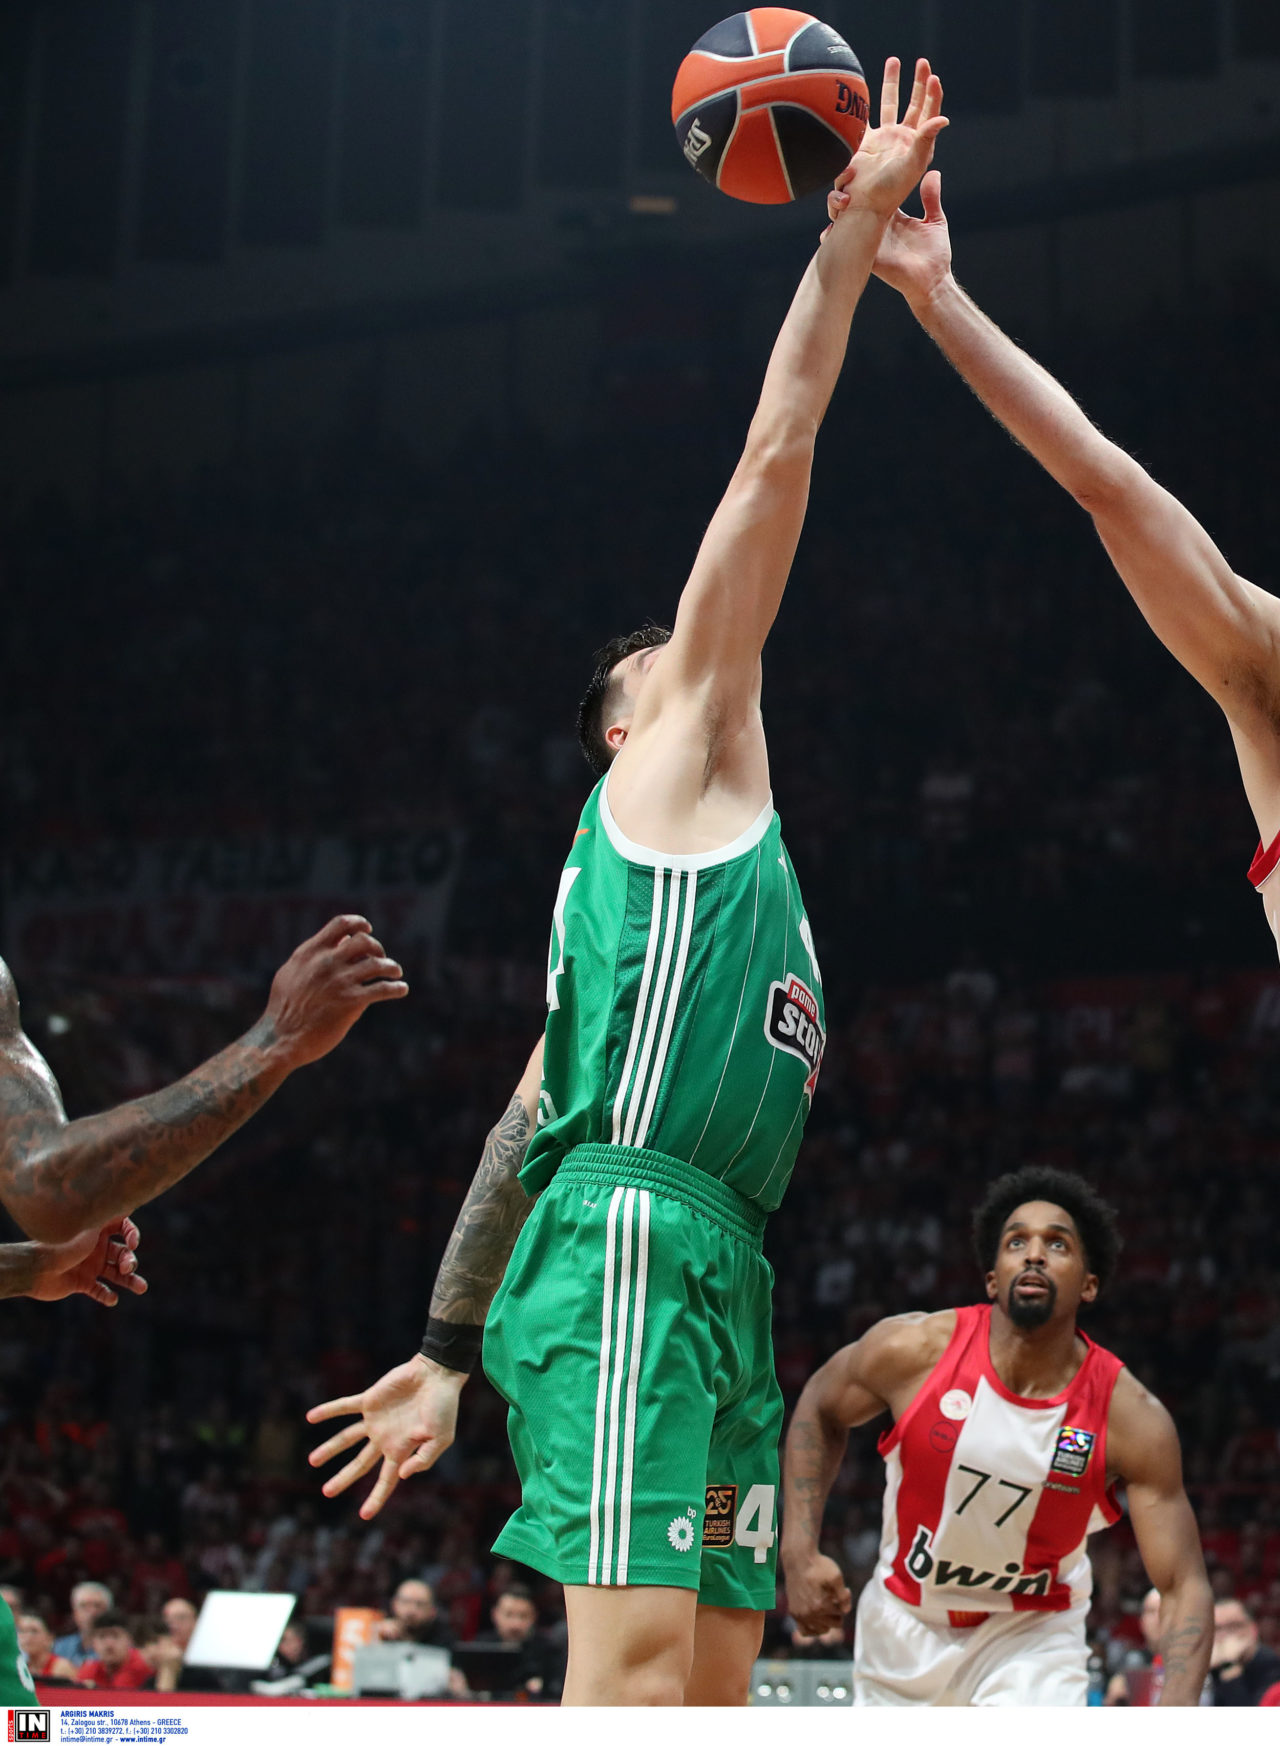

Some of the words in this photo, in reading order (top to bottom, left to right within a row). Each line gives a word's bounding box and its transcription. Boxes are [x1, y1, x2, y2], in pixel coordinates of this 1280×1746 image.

[791, 985, 816, 1017] pame
[705, 1490, 733, 1514] 25
[954, 1463, 1033, 1528] 77
[687, 1506, 697, 1519] bp
[705, 1519, 731, 1527] TURKISH
[907, 1529, 1051, 1596] bwin
